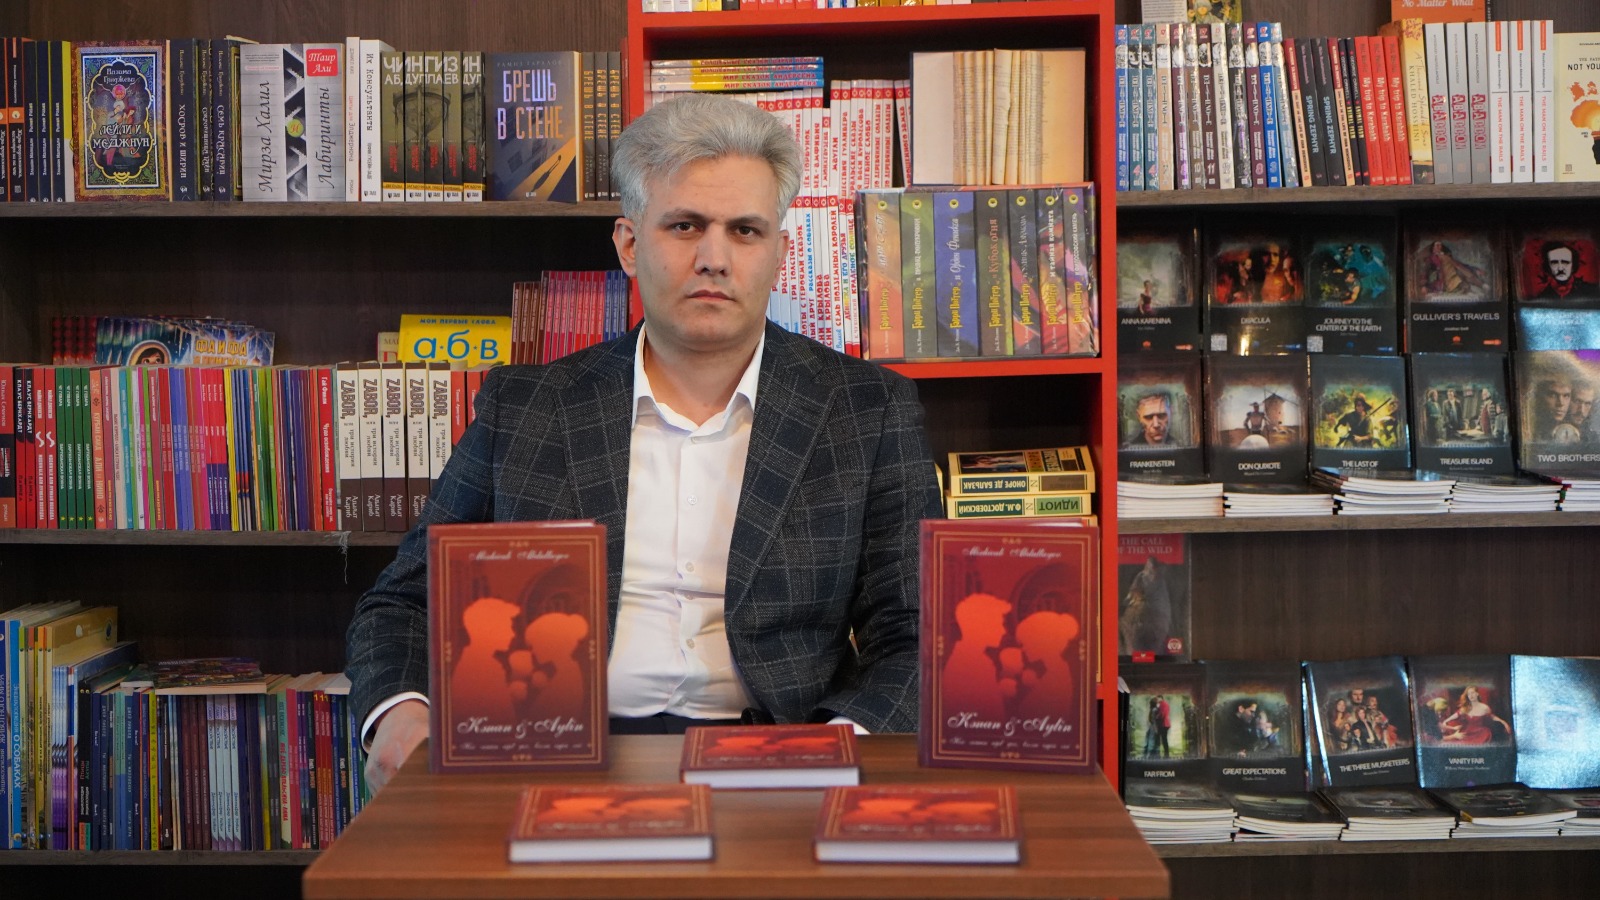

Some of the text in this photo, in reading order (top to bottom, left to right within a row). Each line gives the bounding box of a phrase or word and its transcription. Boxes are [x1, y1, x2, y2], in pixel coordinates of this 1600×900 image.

[308, 53, 336, 64] Таир
[312, 64, 332, 74] Али
[366, 53, 373, 64] Их
[383, 56, 458, 73] ЧИНГИЗ
[384, 73, 459, 85] АБДУЛЛАЕВ
[503, 69, 557, 102] БРЕШЬ
[583, 70, 593, 98] БРЕШЬ
[1362, 77, 1370, 88] My
[256, 80, 272, 133] Халил
[1364, 90, 1372, 101] trip
[99, 123, 142, 136] ЛЕЙЛИ И
[178, 104, 187, 139] ХОСРОВ
[497, 106, 564, 140] В СТЕНЕ
[584, 114, 594, 140] СТЕНЕ
[1305, 95, 1319, 153] SPRING ZEPHYR
[1323, 96, 1337, 154] SPRING ZEPHYR
[1367, 112, 1376, 142] Karabakh
[1432, 95, 1447, 150] ABADDON
[1451, 94, 1466, 150] ABADDON
[1471, 94, 1486, 149] ABADDON
[1498, 124, 1503, 133] ON
[93, 137, 149, 154] МЕДЖНУН
[216, 105, 226, 175] СЕМЬ КРАСАВИЦ
[315, 87, 336, 189] Лабиринты
[258, 136, 277, 192] Мирза
[830, 210, 838, 247] КОРОЛЕЙ
[947, 218, 960, 250] Феникса
[989, 219, 999, 242] огня
[951, 252, 966, 273] Орден
[989, 243, 1000, 273] Кубок
[832, 250, 840, 302] ПОДЗЕМНЫХ
[816, 274, 824, 321] КРЫЛОВА
[949, 287, 960, 309] Поттер
[989, 285, 1000, 308] Поттер
[878, 288, 892, 330] Гарри Поттер
[949, 310, 964, 328] Гарри
[989, 309, 1002, 327] Гарри
[1413, 313, 1461, 321] GULLIVER'S
[1316, 324, 1341, 332] CENTER
[1350, 324, 1362, 332] THE
[1362, 324, 1382, 332] EARTH
[196, 339, 247, 356] ФА И ФА
[340, 380, 355, 419] ZABOR,
[362, 379, 378, 418] ZABOR,
[385, 379, 401, 418] ZABOR,
[1130, 460, 1175, 468] FRANKENSTEIN
[1253, 462, 1280, 470] QUIXOTE
[1342, 460, 1355, 468] THE
[1355, 460, 1368, 468] LAST
[1538, 454, 1600, 463] TWO BROTHERS
[963, 481, 993, 489] БАЛЬЗАК
[994, 480, 1003, 489] ДЕ
[958, 502, 1005, 514] ДОСТОЕВСКИЙ
[1038, 500, 1079, 511] ИДИОТ
[1128, 546, 1145, 554] THE
[1352, 763, 1371, 771] THREE
[1371, 758, 1410, 769] MUSKETEERS
